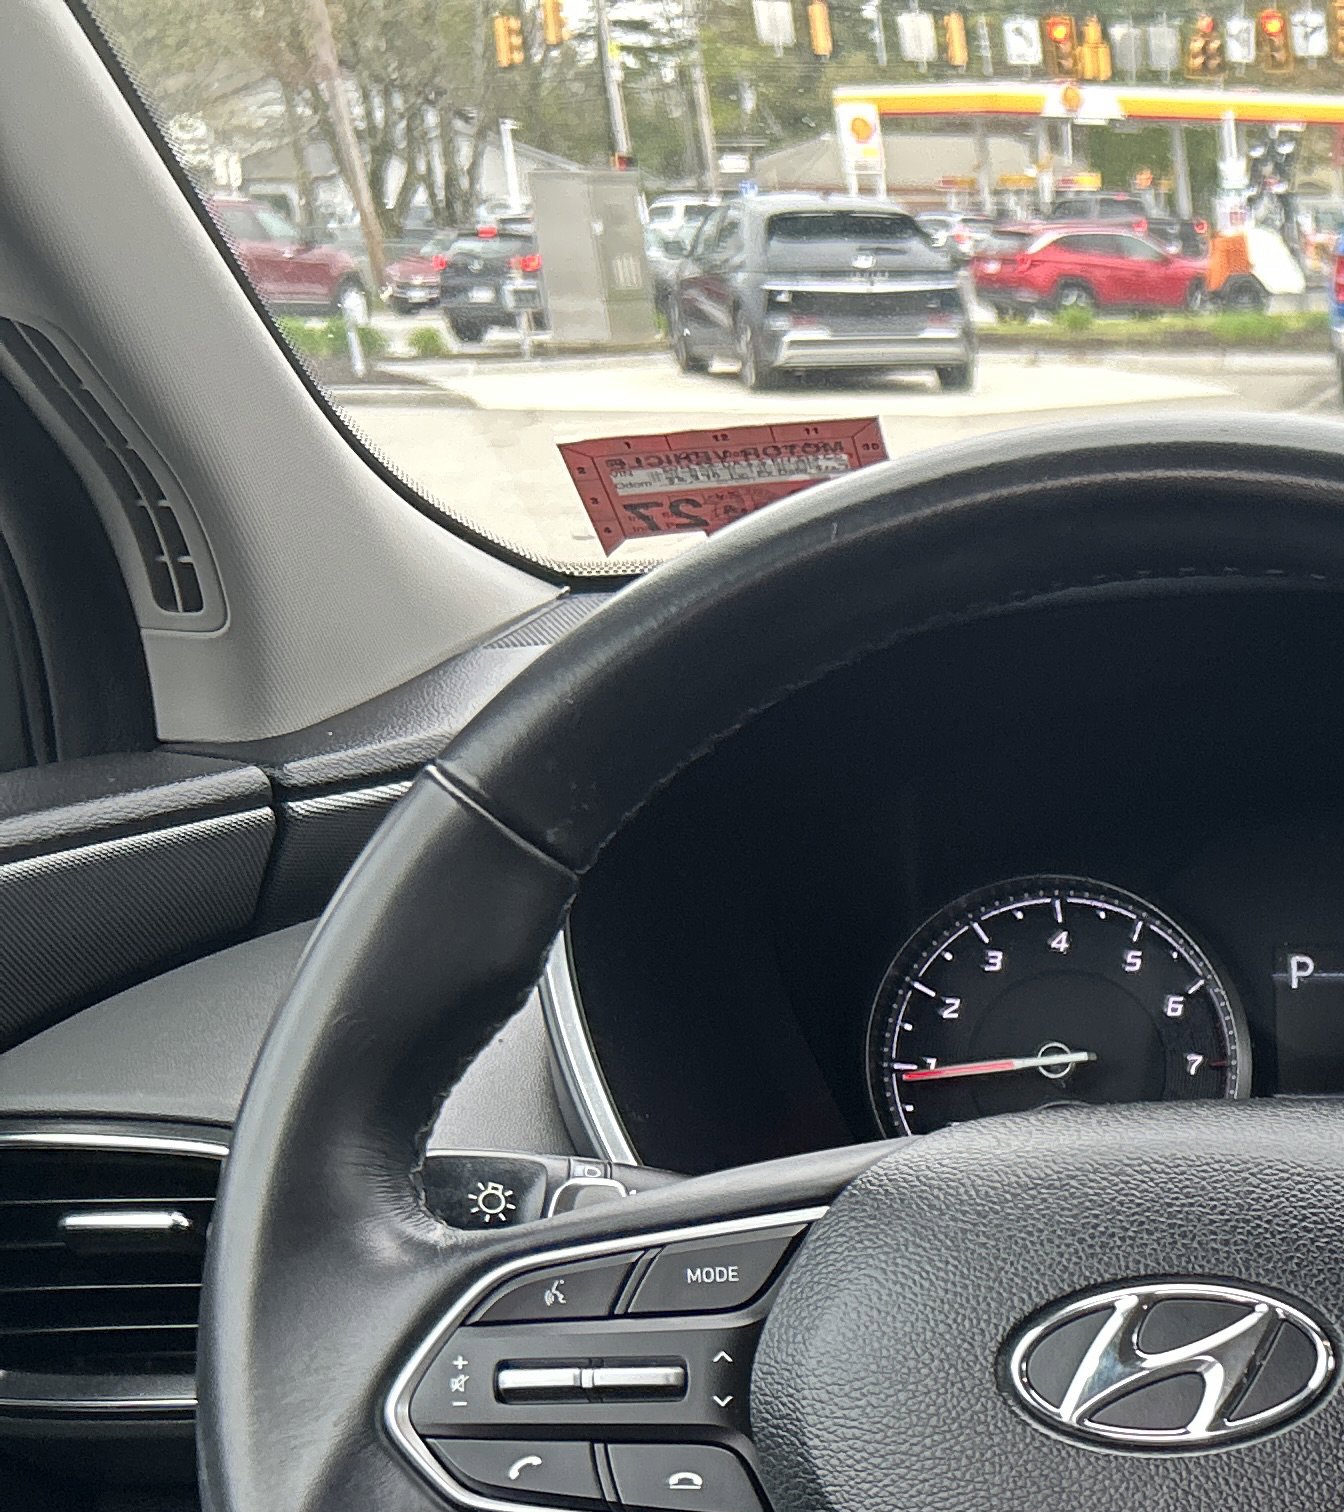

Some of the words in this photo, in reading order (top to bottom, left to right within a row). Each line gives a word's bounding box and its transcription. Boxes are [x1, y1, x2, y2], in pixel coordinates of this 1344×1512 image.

[1050, 931, 1069, 951] 4
[985, 950, 1003, 971] 3
[1125, 951, 1142, 971] 5
[1291, 955, 1314, 989] P
[942, 998, 960, 1018] 2
[1166, 996, 1184, 1016] 6
[1186, 1054, 1203, 1075] 7
[687, 1265, 739, 1284] MODE
